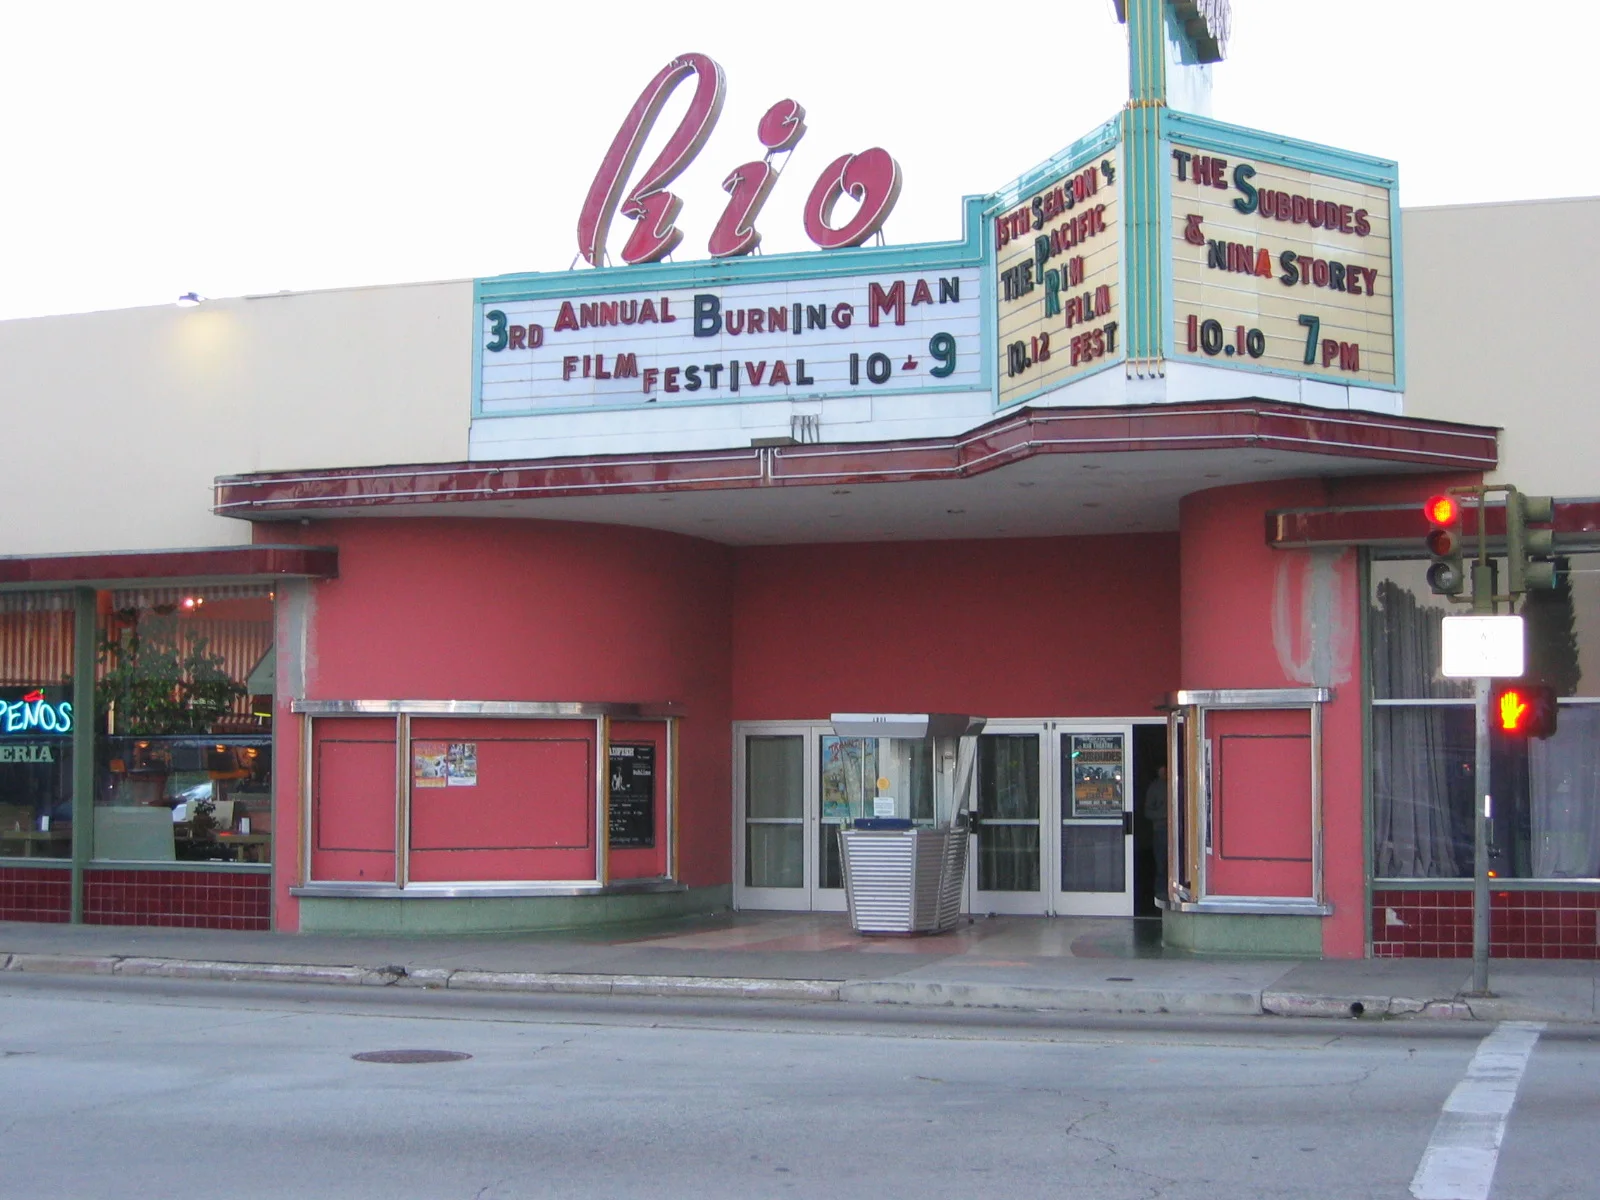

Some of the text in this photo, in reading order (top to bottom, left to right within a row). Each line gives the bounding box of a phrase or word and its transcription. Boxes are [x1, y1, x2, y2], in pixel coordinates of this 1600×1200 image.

[1031, 166, 1097, 231] SEASON
[1173, 148, 1372, 237] THE SUBDUDES
[1000, 203, 1107, 302] THE PACIFIC
[1207, 239, 1379, 297] NINA STOREY
[485, 275, 961, 353] 3RD ANNUAL BURNING MAN
[1044, 254, 1085, 319] RIM
[1064, 284, 1112, 329] FILM
[562, 351, 638, 381] FILM
[643, 352, 815, 394] FESTIVAL
[1070, 320, 1118, 367] FEST
